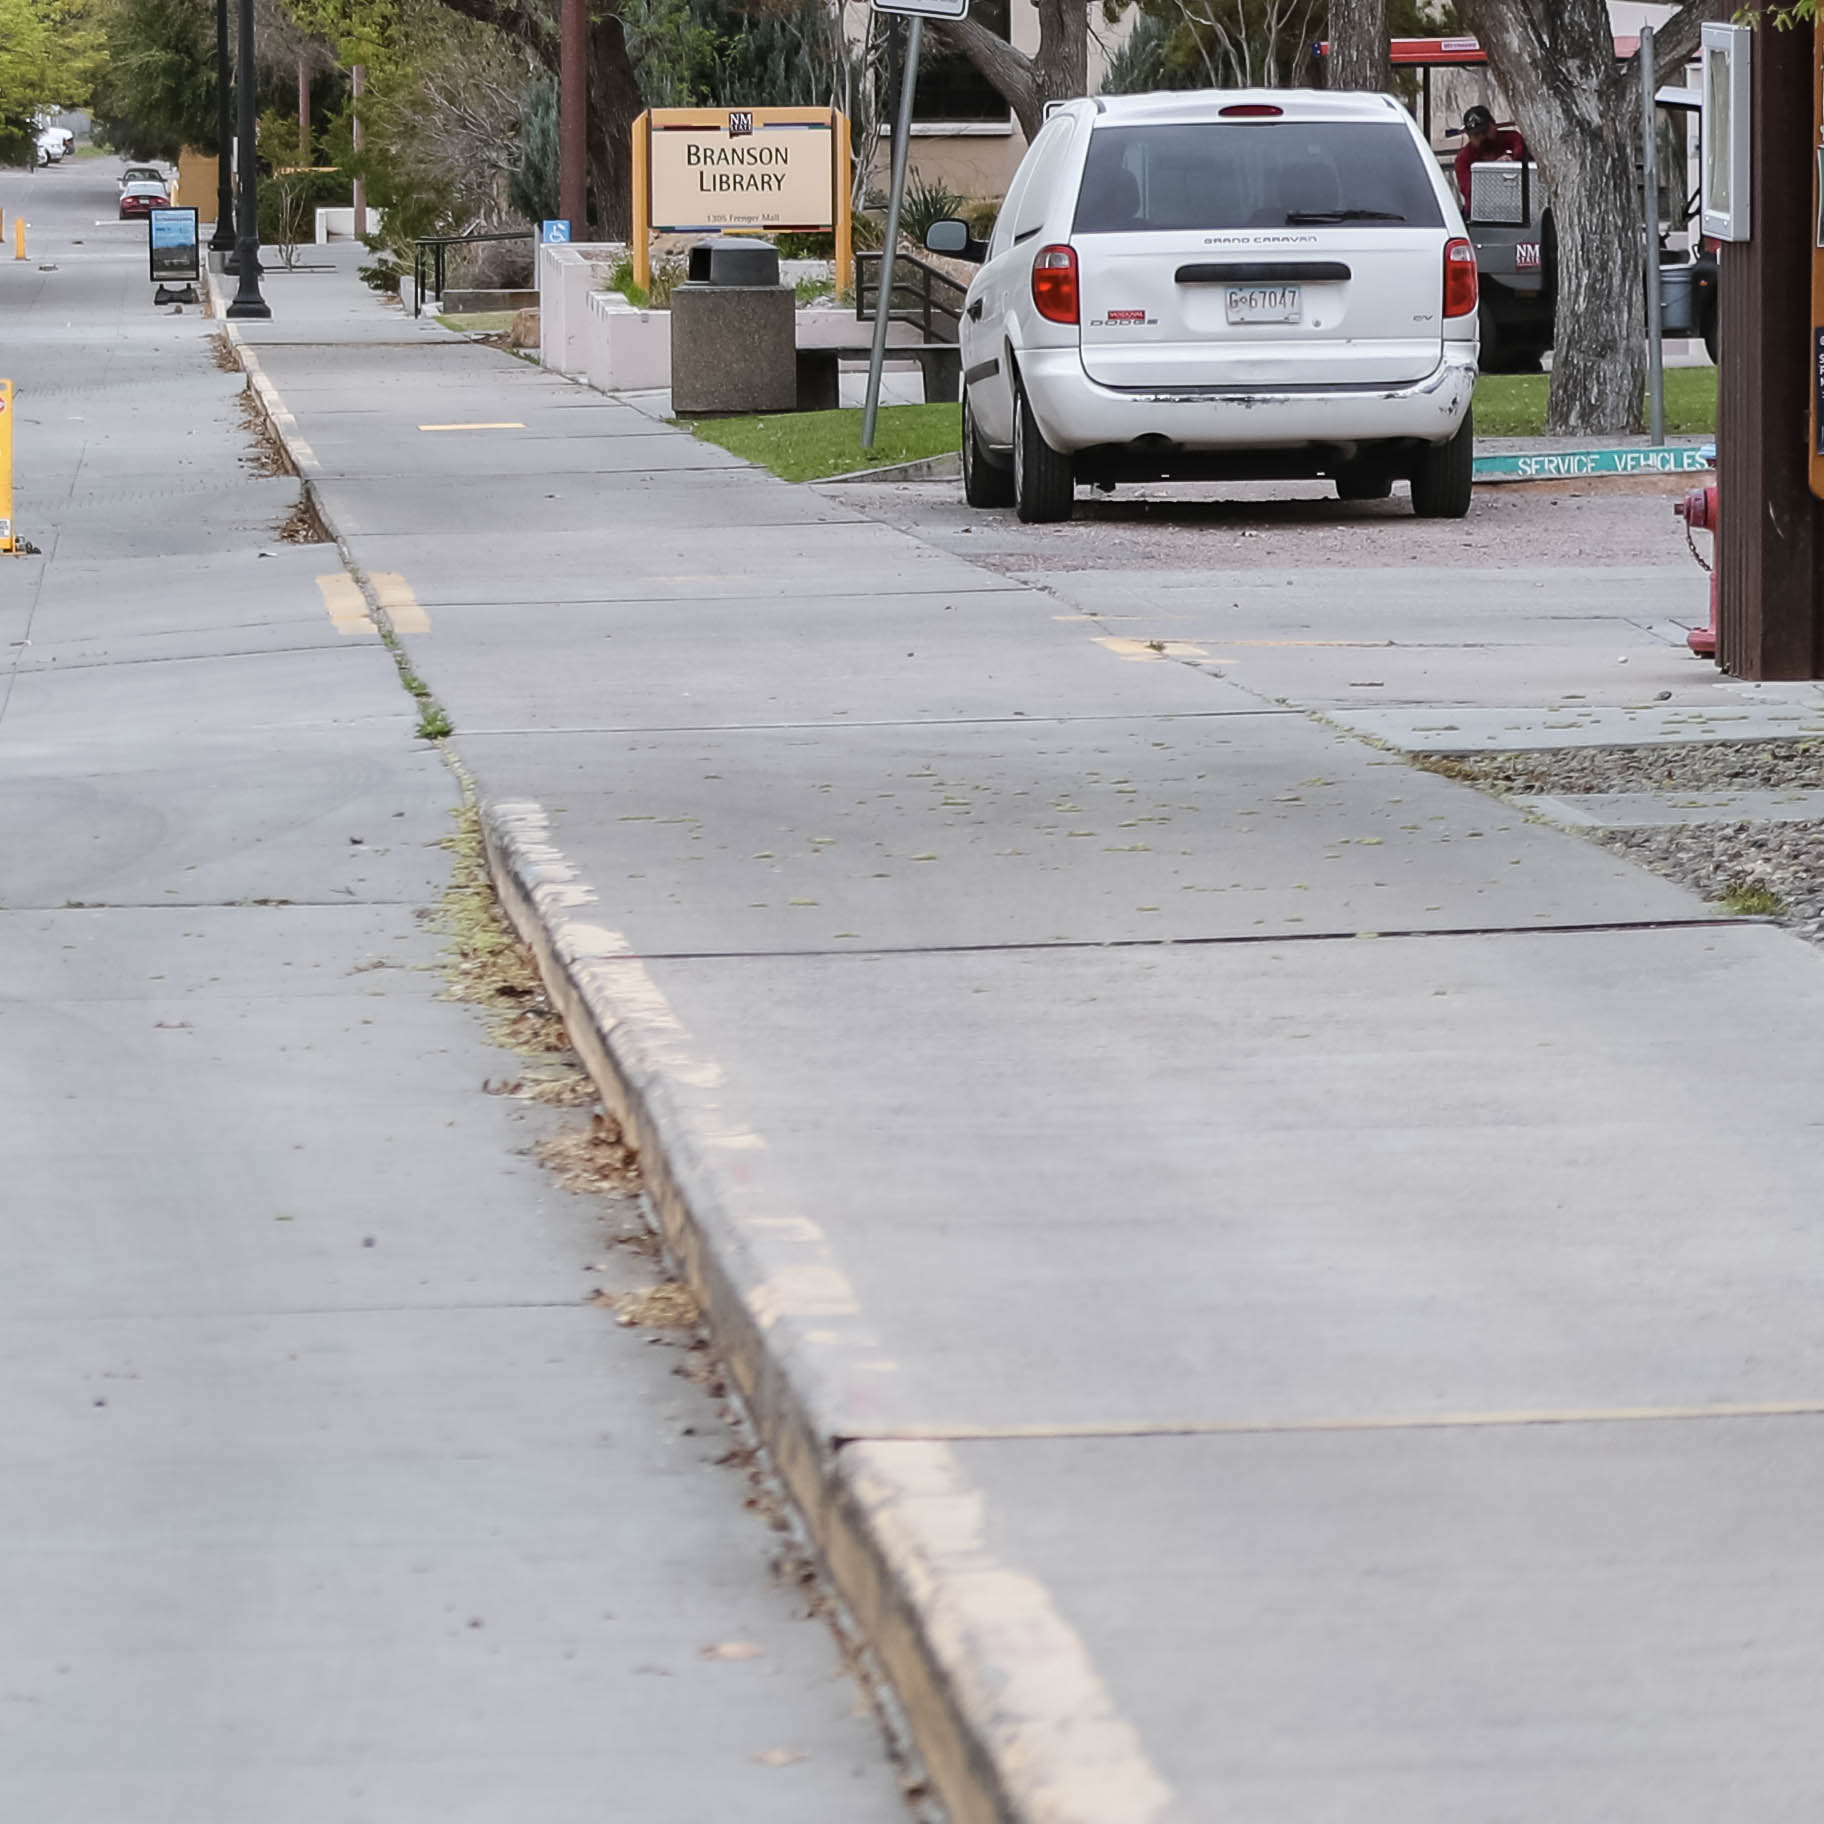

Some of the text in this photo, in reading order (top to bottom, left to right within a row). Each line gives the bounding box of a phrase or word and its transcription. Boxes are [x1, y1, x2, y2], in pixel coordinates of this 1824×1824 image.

[687, 144, 789, 166] BRANSON
[699, 170, 786, 192] LIBRARY
[1203, 235, 1318, 245] GRAND CARAVAN
[1516, 243, 1540, 257] NM
[1517, 450, 1710, 476] SERVICE VEHICLES
